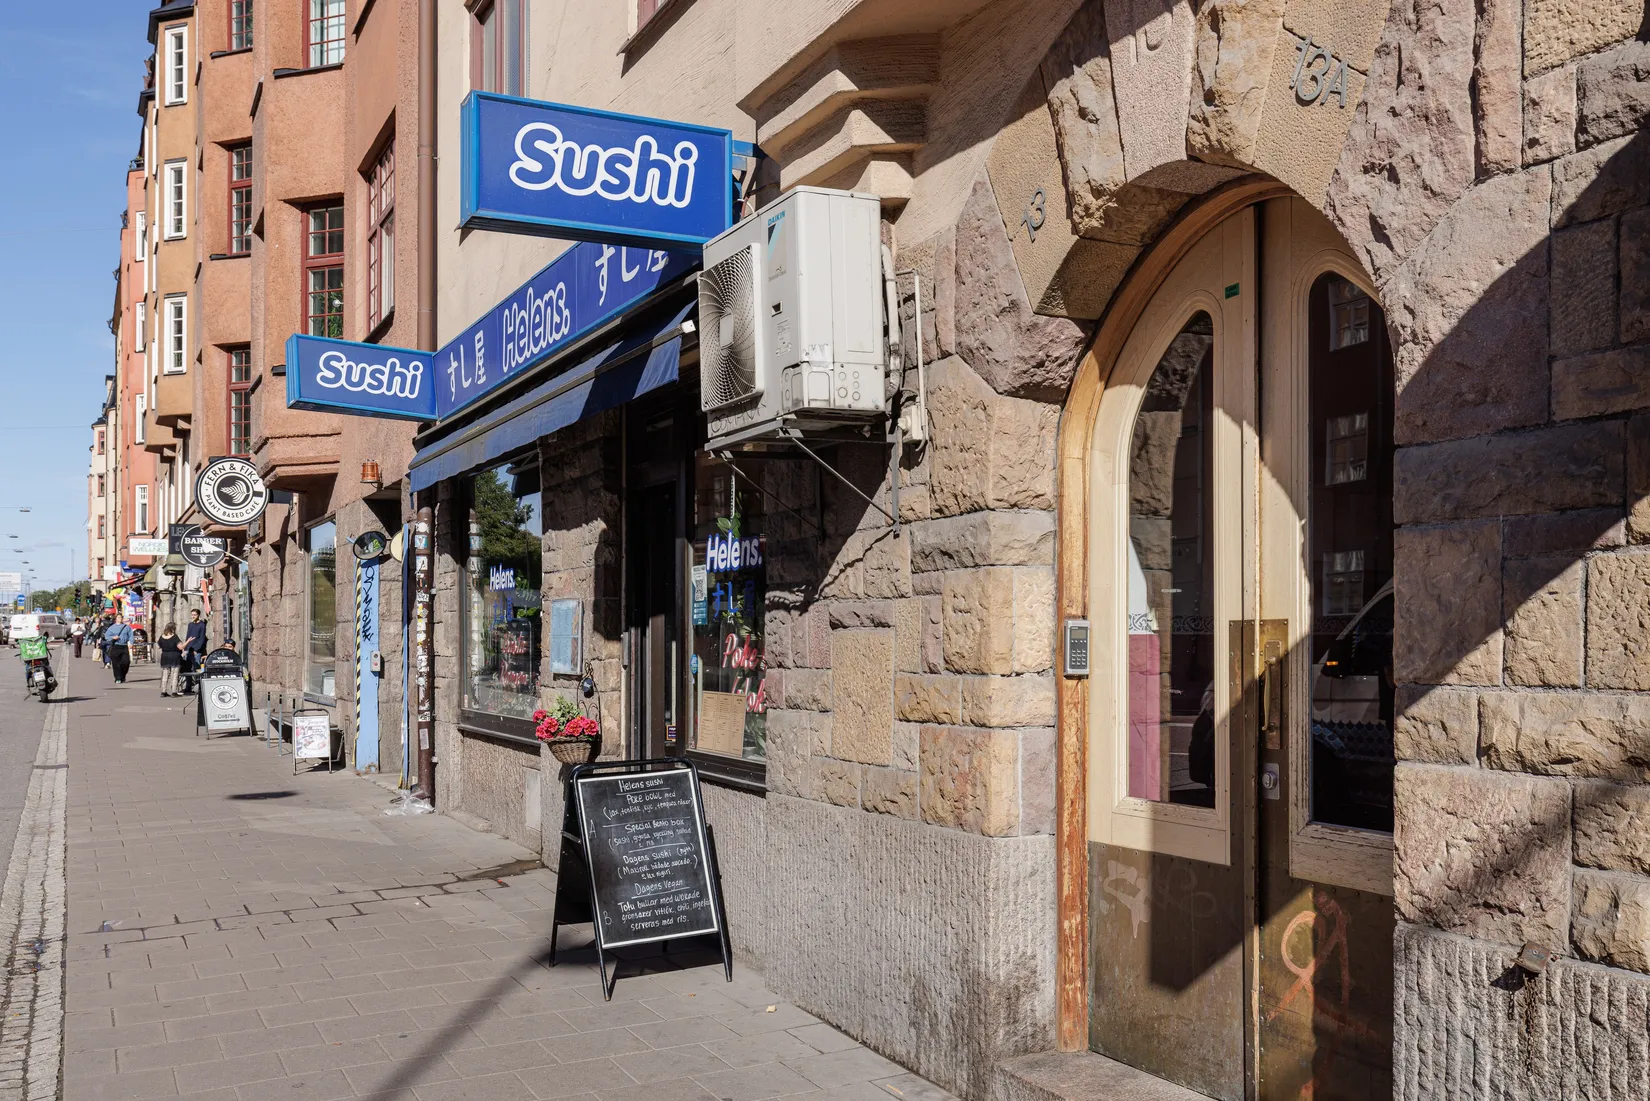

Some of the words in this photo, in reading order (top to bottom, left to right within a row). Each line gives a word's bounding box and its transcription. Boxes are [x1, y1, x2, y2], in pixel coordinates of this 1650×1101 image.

[1291, 34, 1347, 107] 13A
[508, 122, 699, 208] Sushi
[767, 209, 786, 226] DAIKIN
[1020, 187, 1046, 240] 13
[316, 351, 424, 399] Sushi
[447, 329, 487, 402] すし屋
[204, 465, 227, 487] FERN
[229, 463, 237, 471] &
[239, 465, 260, 485] FIKA
[205, 494, 221, 513] PLANT
[222, 510, 244, 519] BASED
[618, 779, 645, 792] Helens
[622, 854, 650, 865] Dagens
[634, 882, 663, 896] Dagens
[663, 879, 683, 891] Vegan
[617, 901, 636, 913] Tofu
[660, 895, 673, 904] med
[630, 920, 660, 932] serveras
[661, 917, 674, 926] med
